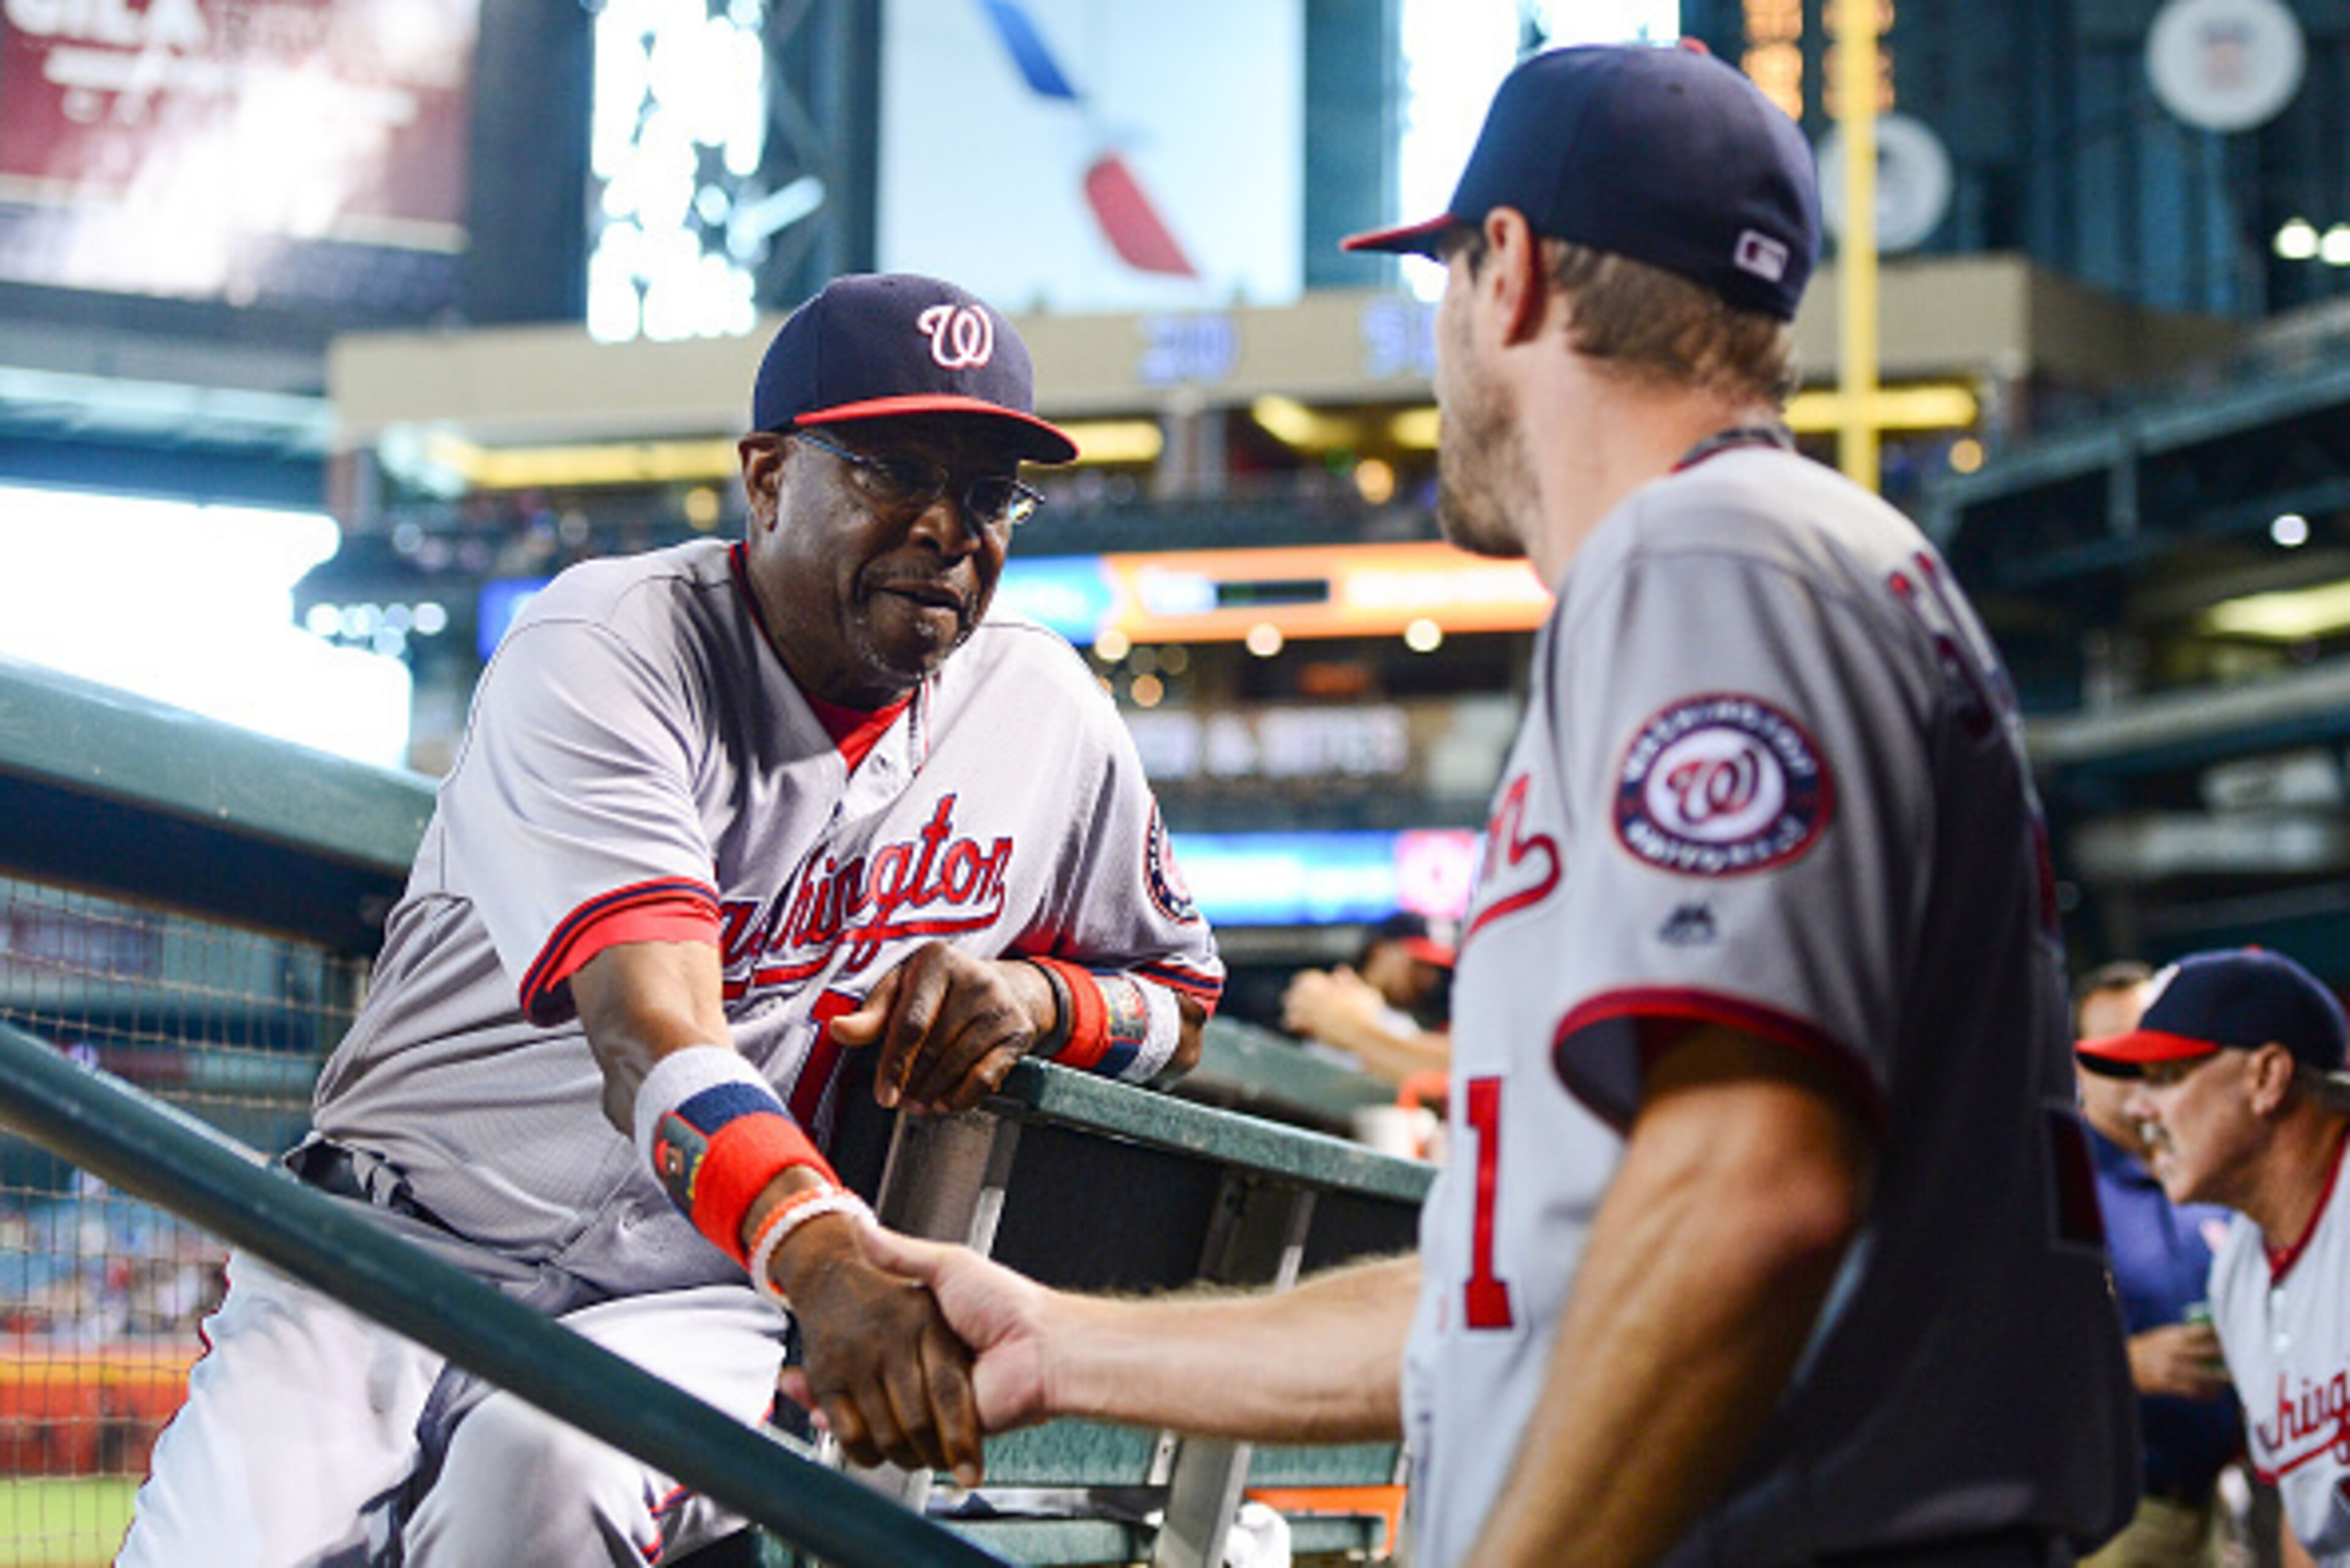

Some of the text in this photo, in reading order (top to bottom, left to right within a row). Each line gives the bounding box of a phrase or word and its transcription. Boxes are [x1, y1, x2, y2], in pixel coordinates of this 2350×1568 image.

[916, 304, 993, 370] W
[1666, 748, 1760, 826] W
[721, 793, 1013, 973] ahington
